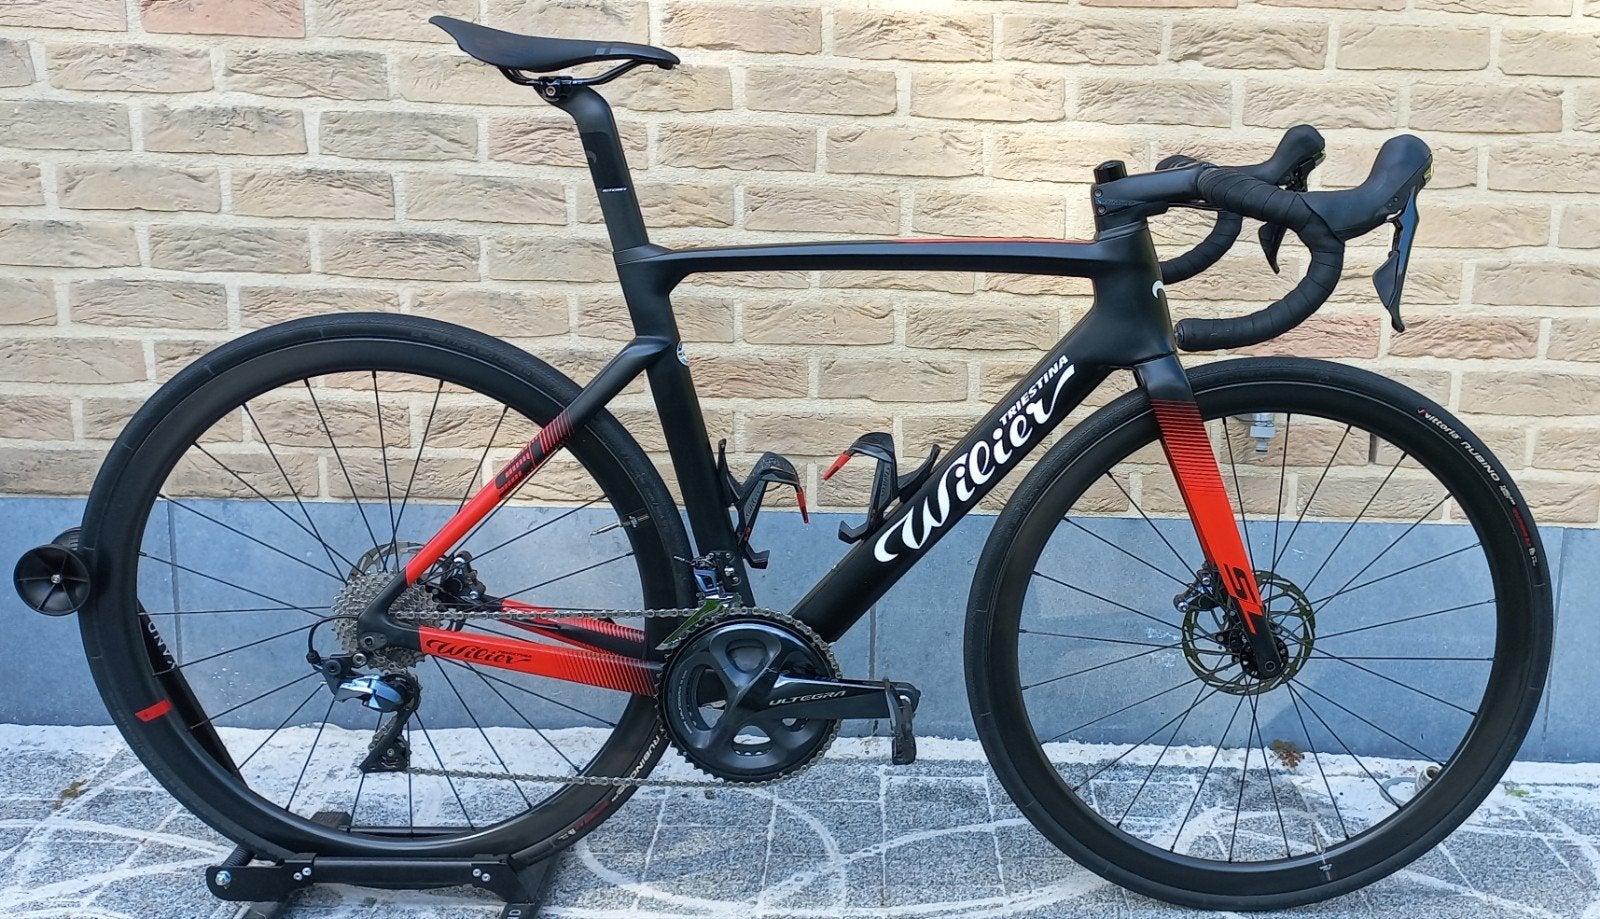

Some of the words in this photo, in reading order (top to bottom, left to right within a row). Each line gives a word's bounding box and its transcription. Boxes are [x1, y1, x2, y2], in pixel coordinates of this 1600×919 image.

[999, 355, 1069, 426] TRIESTINA
[874, 364, 1075, 562] Wilier
[1461, 441, 1500, 482] RUBINO
[426, 639, 532, 664] Wilier
[769, 690, 846, 706] ULTEGRA
[630, 735, 660, 779] RUBINO
